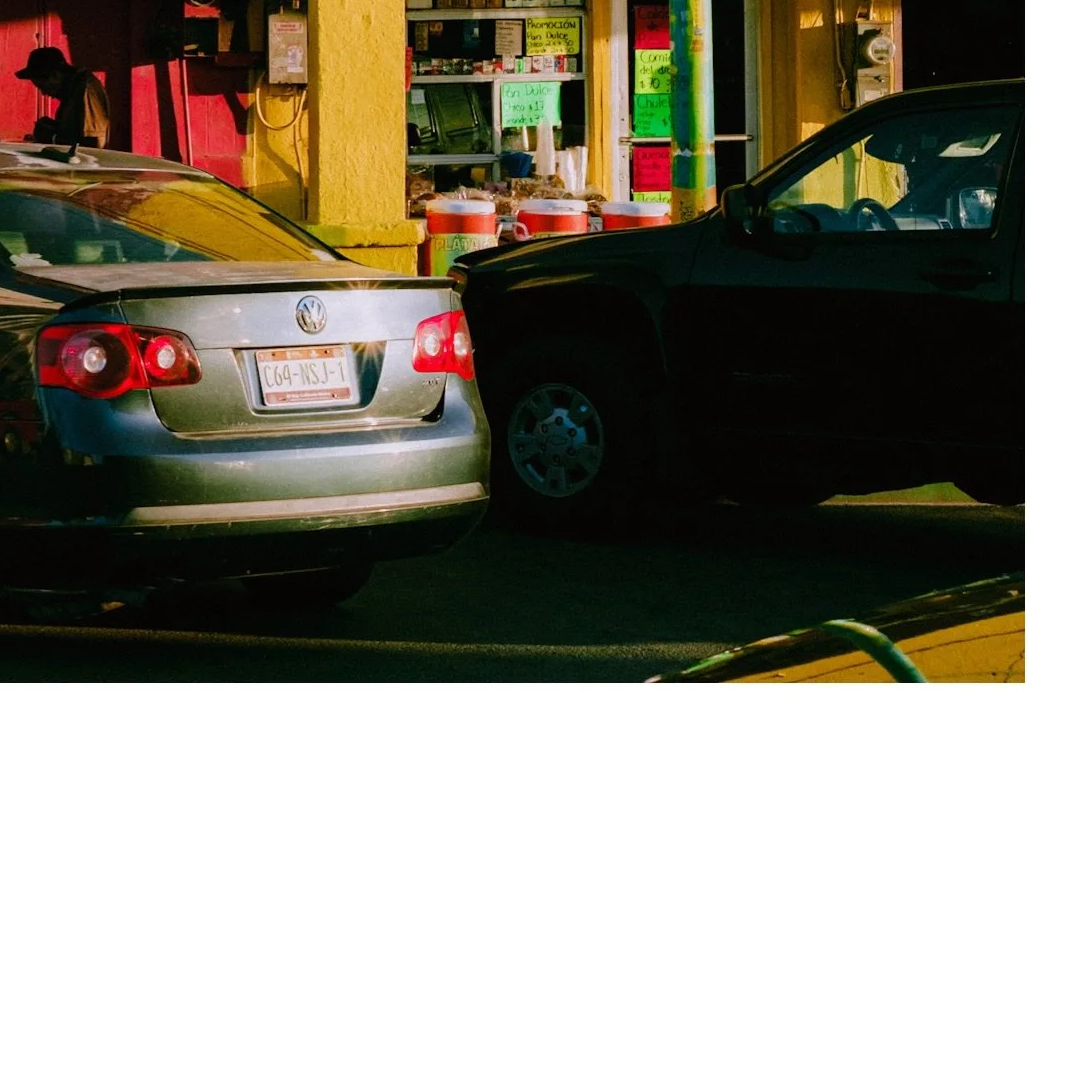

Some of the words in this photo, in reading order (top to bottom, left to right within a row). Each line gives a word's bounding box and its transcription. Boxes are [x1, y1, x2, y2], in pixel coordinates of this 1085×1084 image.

[527, 18, 576, 29] PROMOCIÓN
[527, 31, 542, 41] Pan
[546, 31, 568, 41] Dulce
[503, 83, 519, 98] Pan
[525, 83, 555, 96] Dulce
[263, 360, 346, 388] C64-NSJ-1
